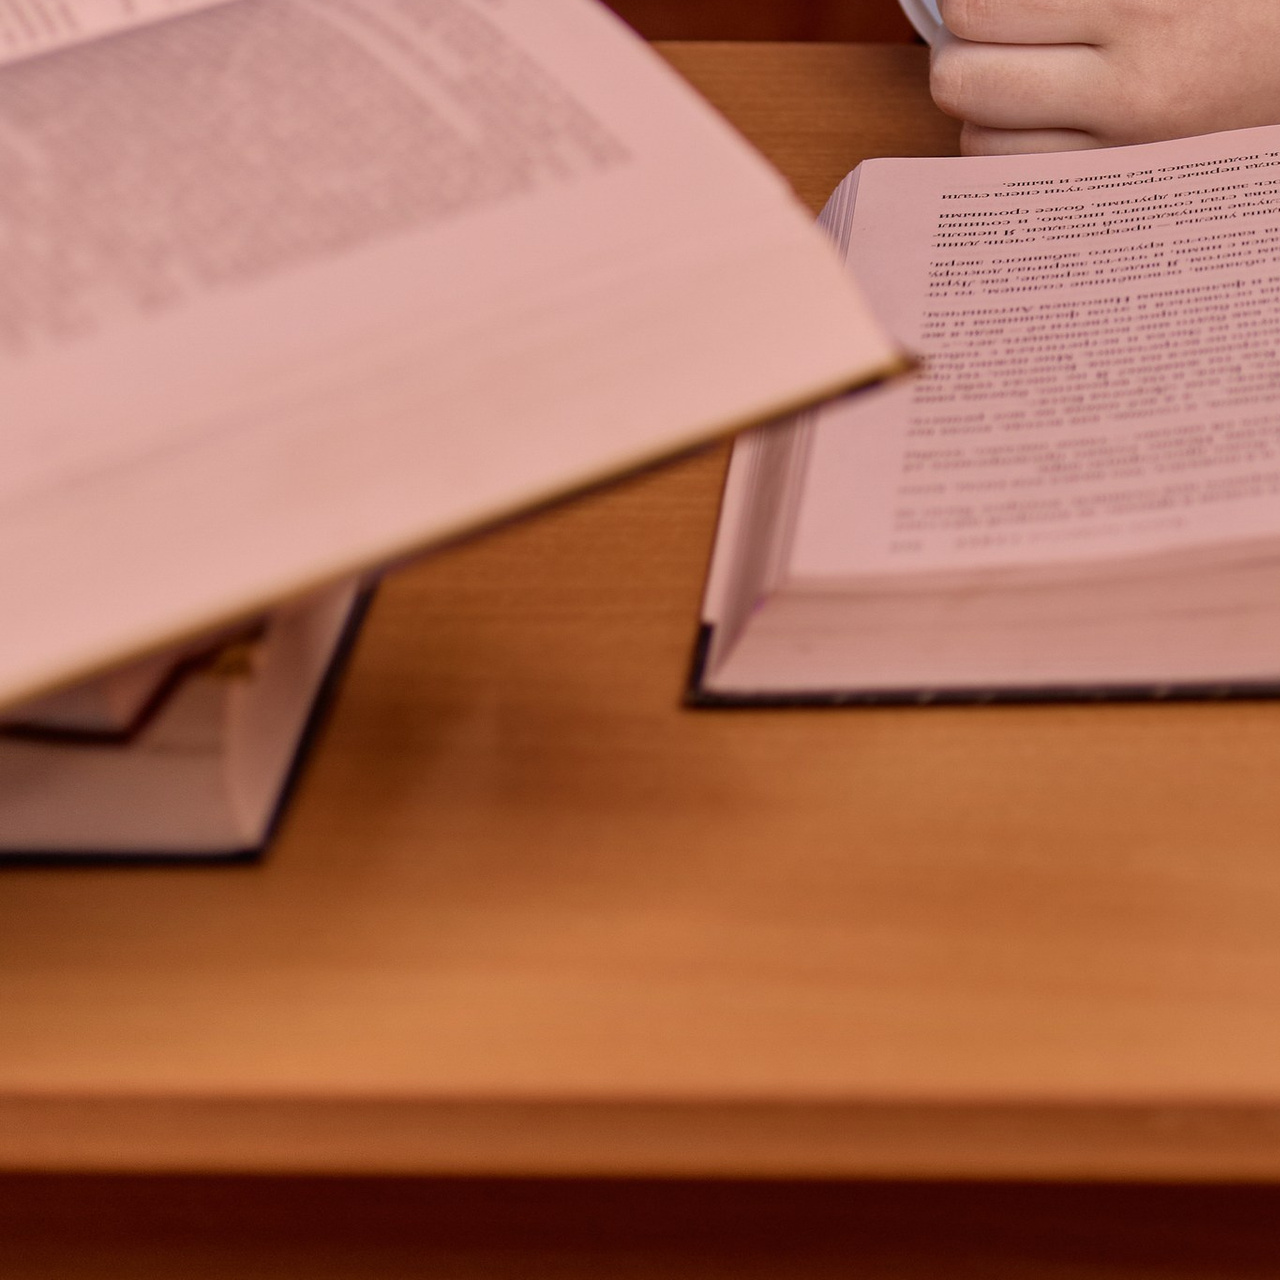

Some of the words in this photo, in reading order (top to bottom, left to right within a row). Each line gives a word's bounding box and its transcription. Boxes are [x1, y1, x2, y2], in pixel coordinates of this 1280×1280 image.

[1157, 154, 1260, 175] поднимаясь
[1074, 173, 1122, 184] выше
[1126, 169, 1153, 181] всё
[1177, 165, 1241, 181] первые
[1087, 175, 1174, 192] огромные
[994, 190, 1041, 199] снега
[1044, 185, 1084, 196] тучи
[1174, 183, 1249, 199] заняться
[1200, 194, 1238, 205] стал
[939, 207, 1030, 220] срочными
[1035, 204, 1086, 215] более
[1111, 200, 1194, 217] сочинять
[1120, 205, 1223, 227] вынужденной
[1175, 211, 1237, 227] ущелья
[938, 219, 1012, 230] сочинял
[984, 237, 1036, 247] очень
